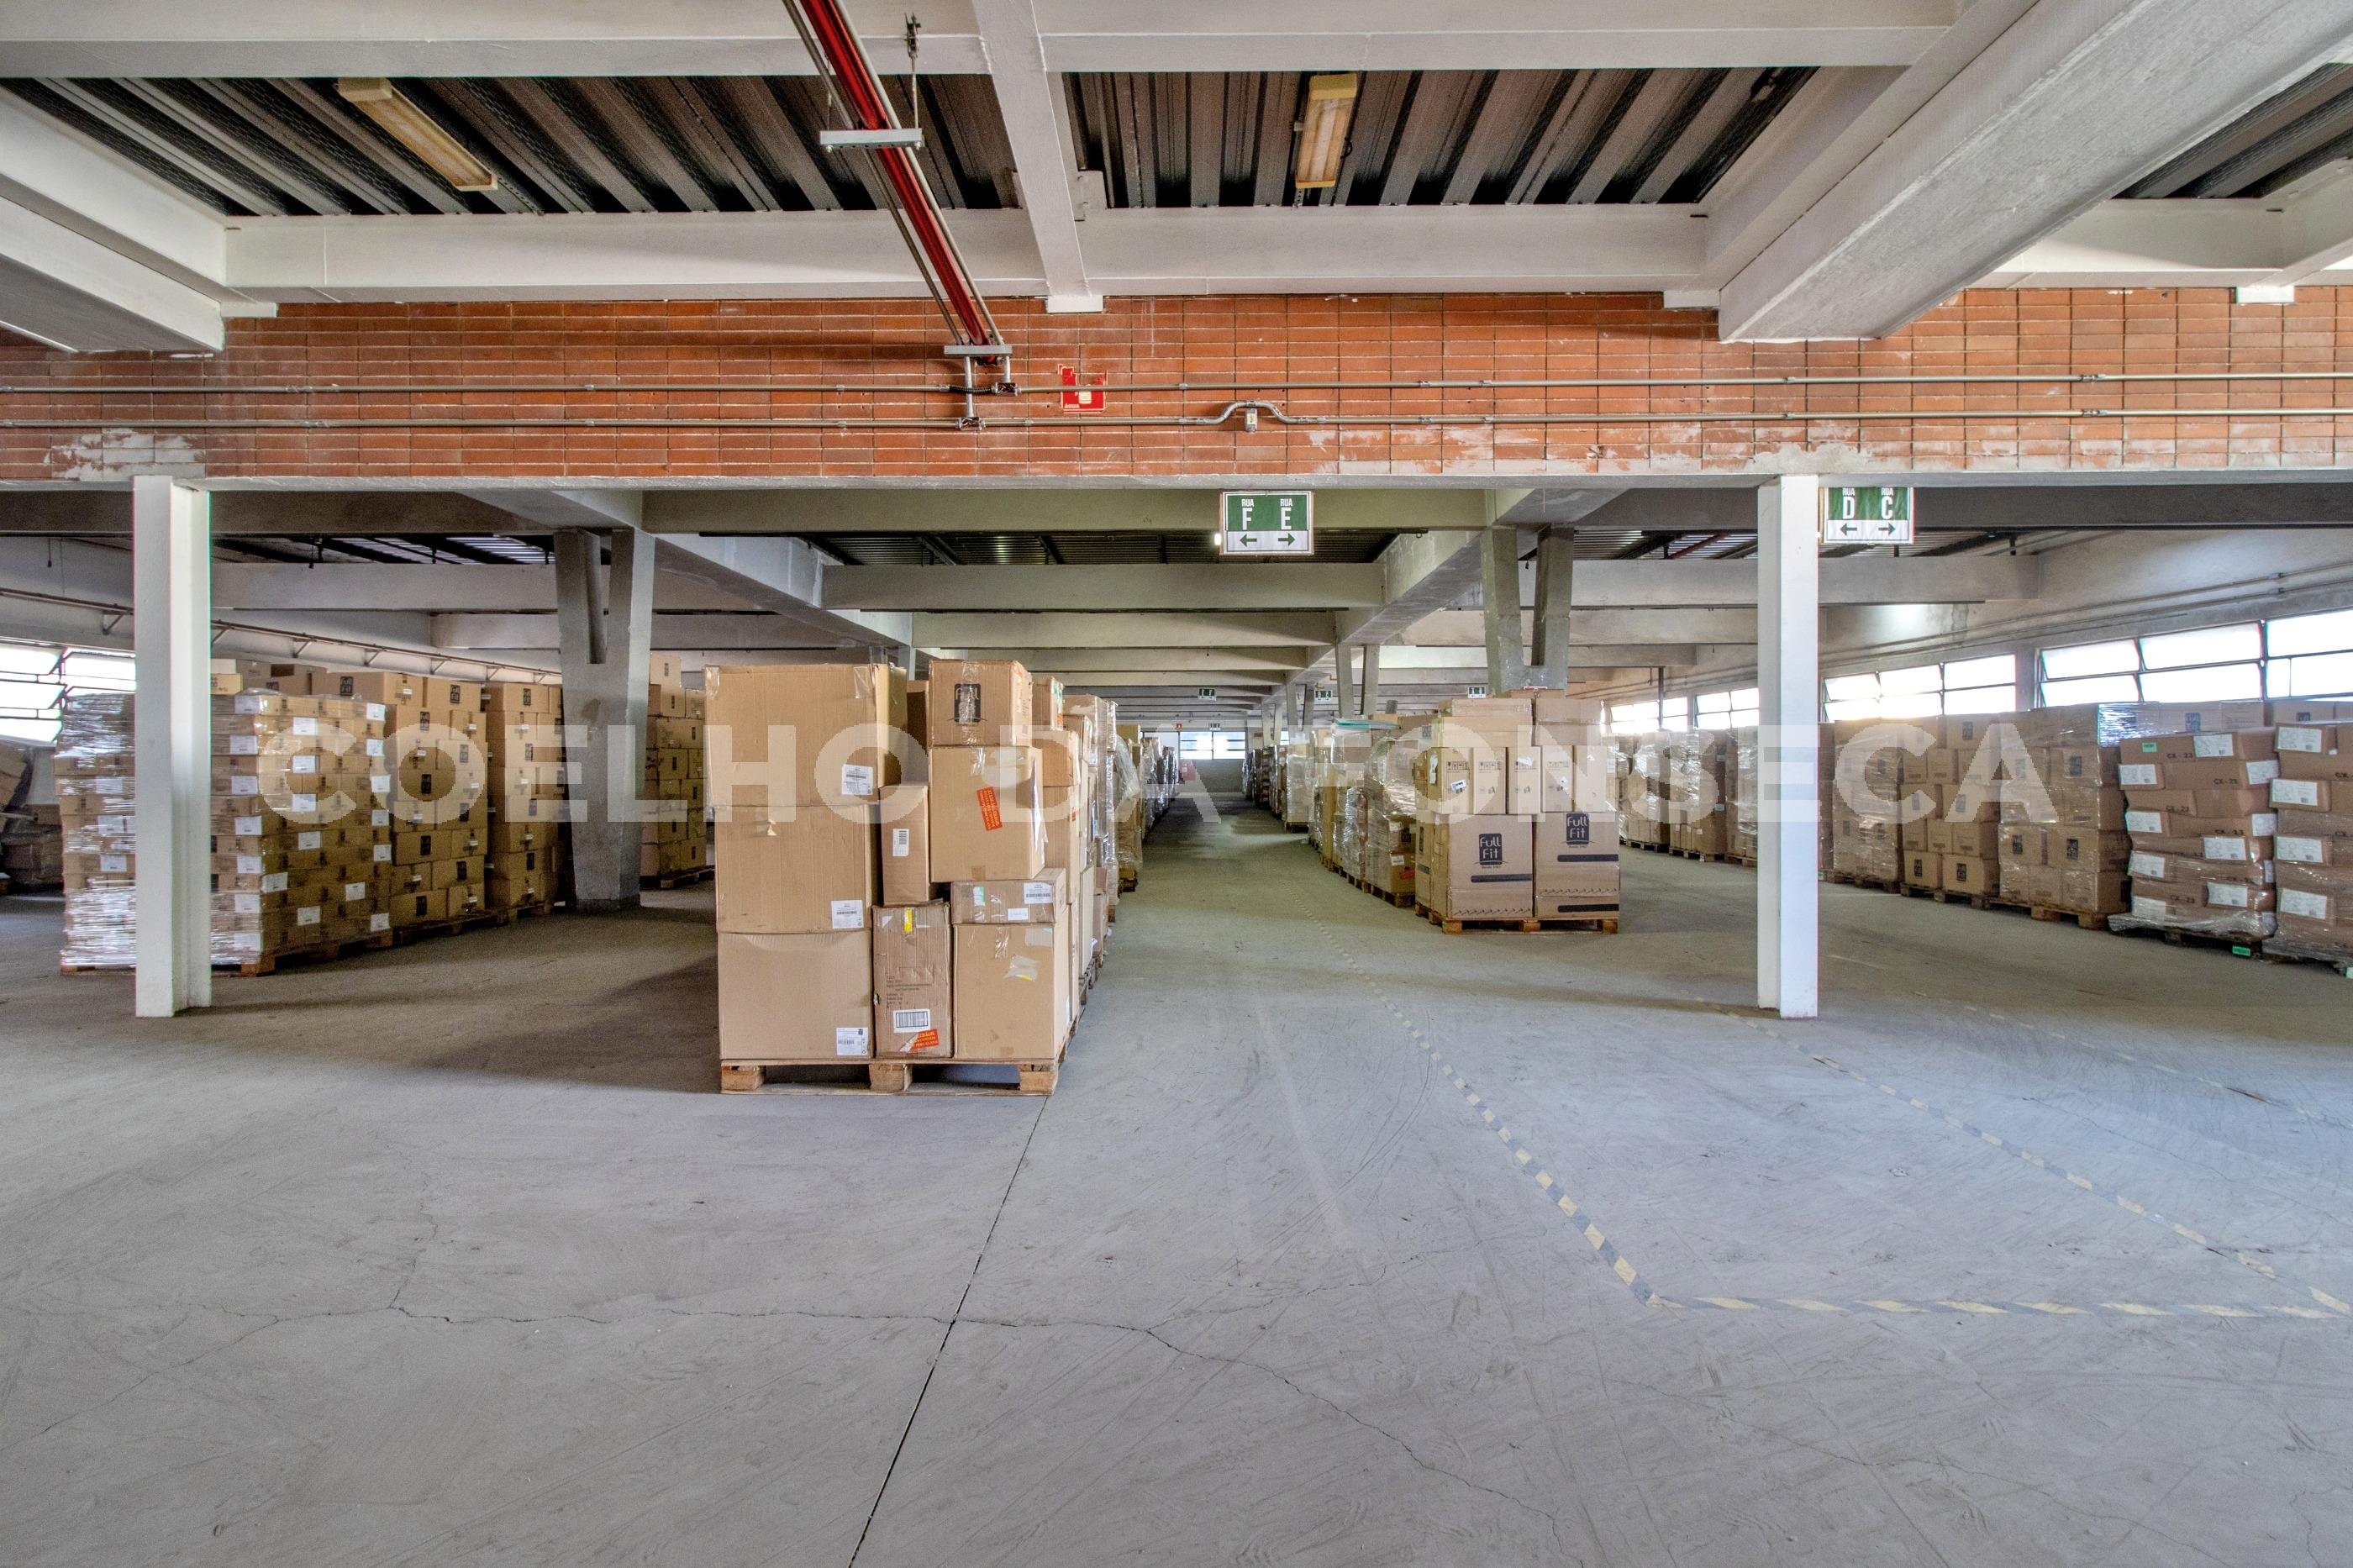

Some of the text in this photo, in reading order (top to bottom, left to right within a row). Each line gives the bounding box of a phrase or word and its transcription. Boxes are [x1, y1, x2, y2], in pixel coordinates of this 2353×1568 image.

[1842, 487, 1856, 496] RUA
[1881, 487, 1894, 496] RUA
[1241, 498, 1255, 508] RUA
[1280, 498, 1293, 507] RUA
[1842, 496, 1856, 519] D
[1881, 496, 1893, 519] C
[1242, 507, 1253, 530] F
[1281, 507, 1292, 530] E
[1566, 816, 1588, 827] Full
[1570, 828, 1586, 839] Fit
[1479, 836, 1501, 848] Full
[1482, 848, 1499, 859] Fit
